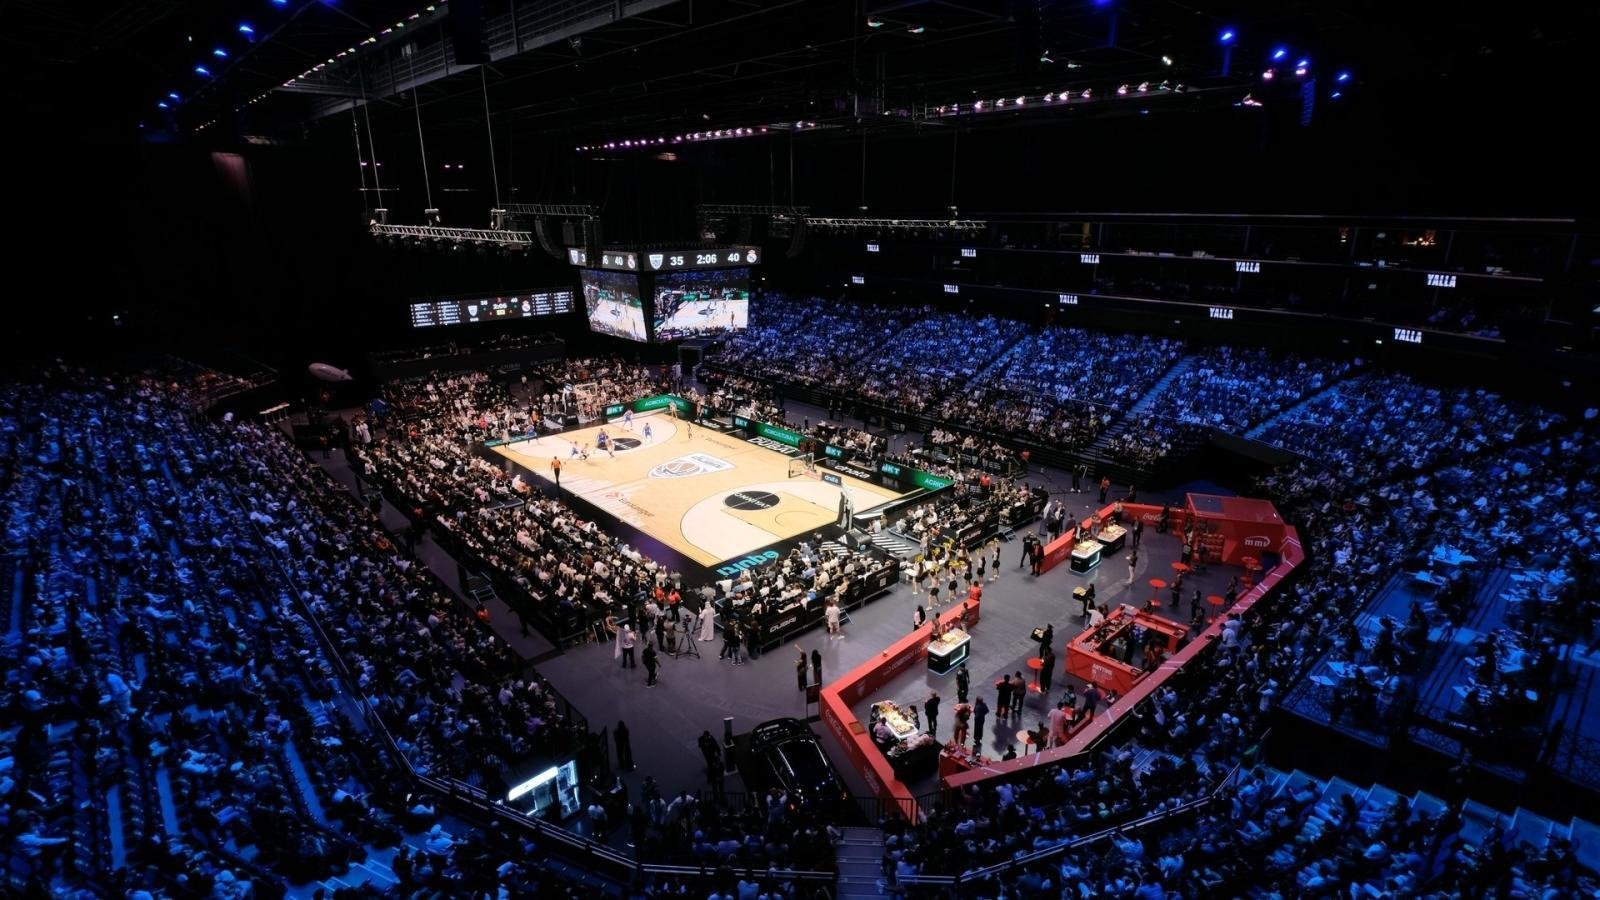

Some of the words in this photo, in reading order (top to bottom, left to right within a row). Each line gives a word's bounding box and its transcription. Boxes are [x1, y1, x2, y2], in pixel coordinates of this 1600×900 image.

[727, 252, 740, 263] 40
[961, 248, 976, 257] YALLA
[614, 256, 624, 266] 40
[670, 255, 684, 266] 35
[696, 253, 717, 265] 2:06
[1081, 254, 1100, 264] YALLA
[1235, 261, 1260, 273] YALLA
[1427, 273, 1456, 288] YALLA
[943, 284, 958, 294] YALLA
[1059, 294, 1078, 305] YALLA
[1209, 307, 1233, 320] YALLA
[1394, 328, 1422, 344] YALLA
[924, 478, 945, 488] AGRIC
